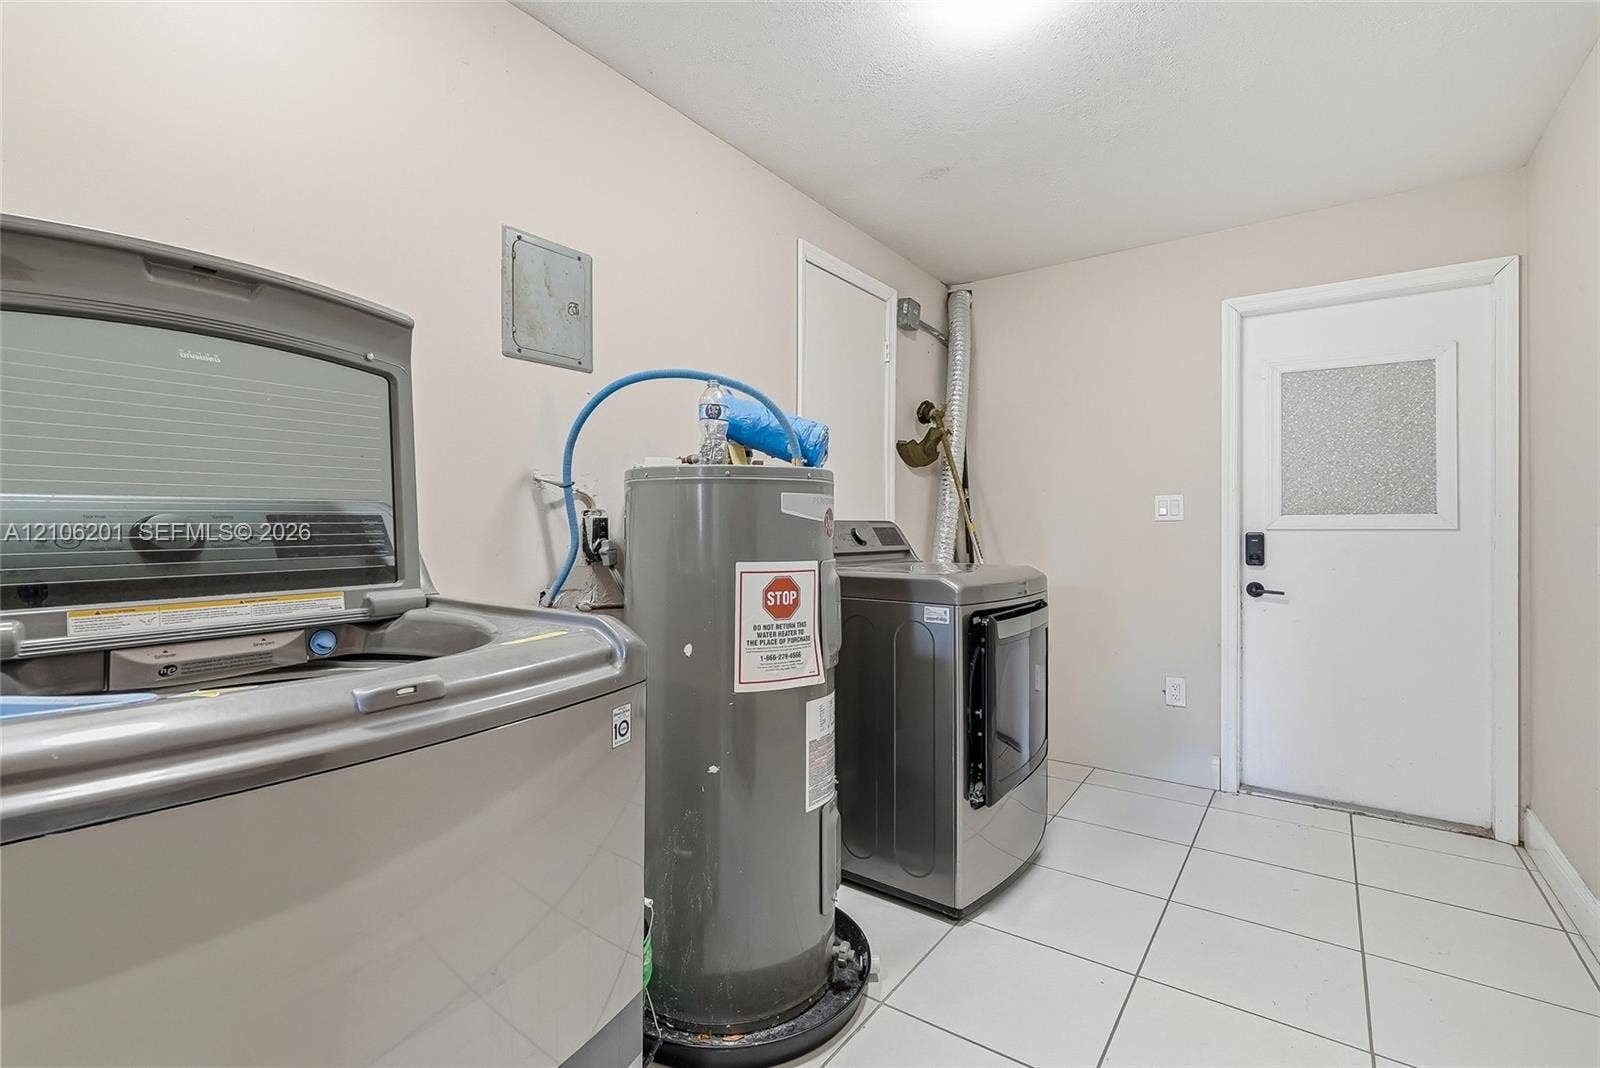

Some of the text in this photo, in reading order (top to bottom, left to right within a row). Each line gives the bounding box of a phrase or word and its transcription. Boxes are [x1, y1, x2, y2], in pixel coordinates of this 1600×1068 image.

[767, 591, 797, 606] STOP
[763, 623, 774, 631] NOT
[778, 629, 797, 637] HEATER
